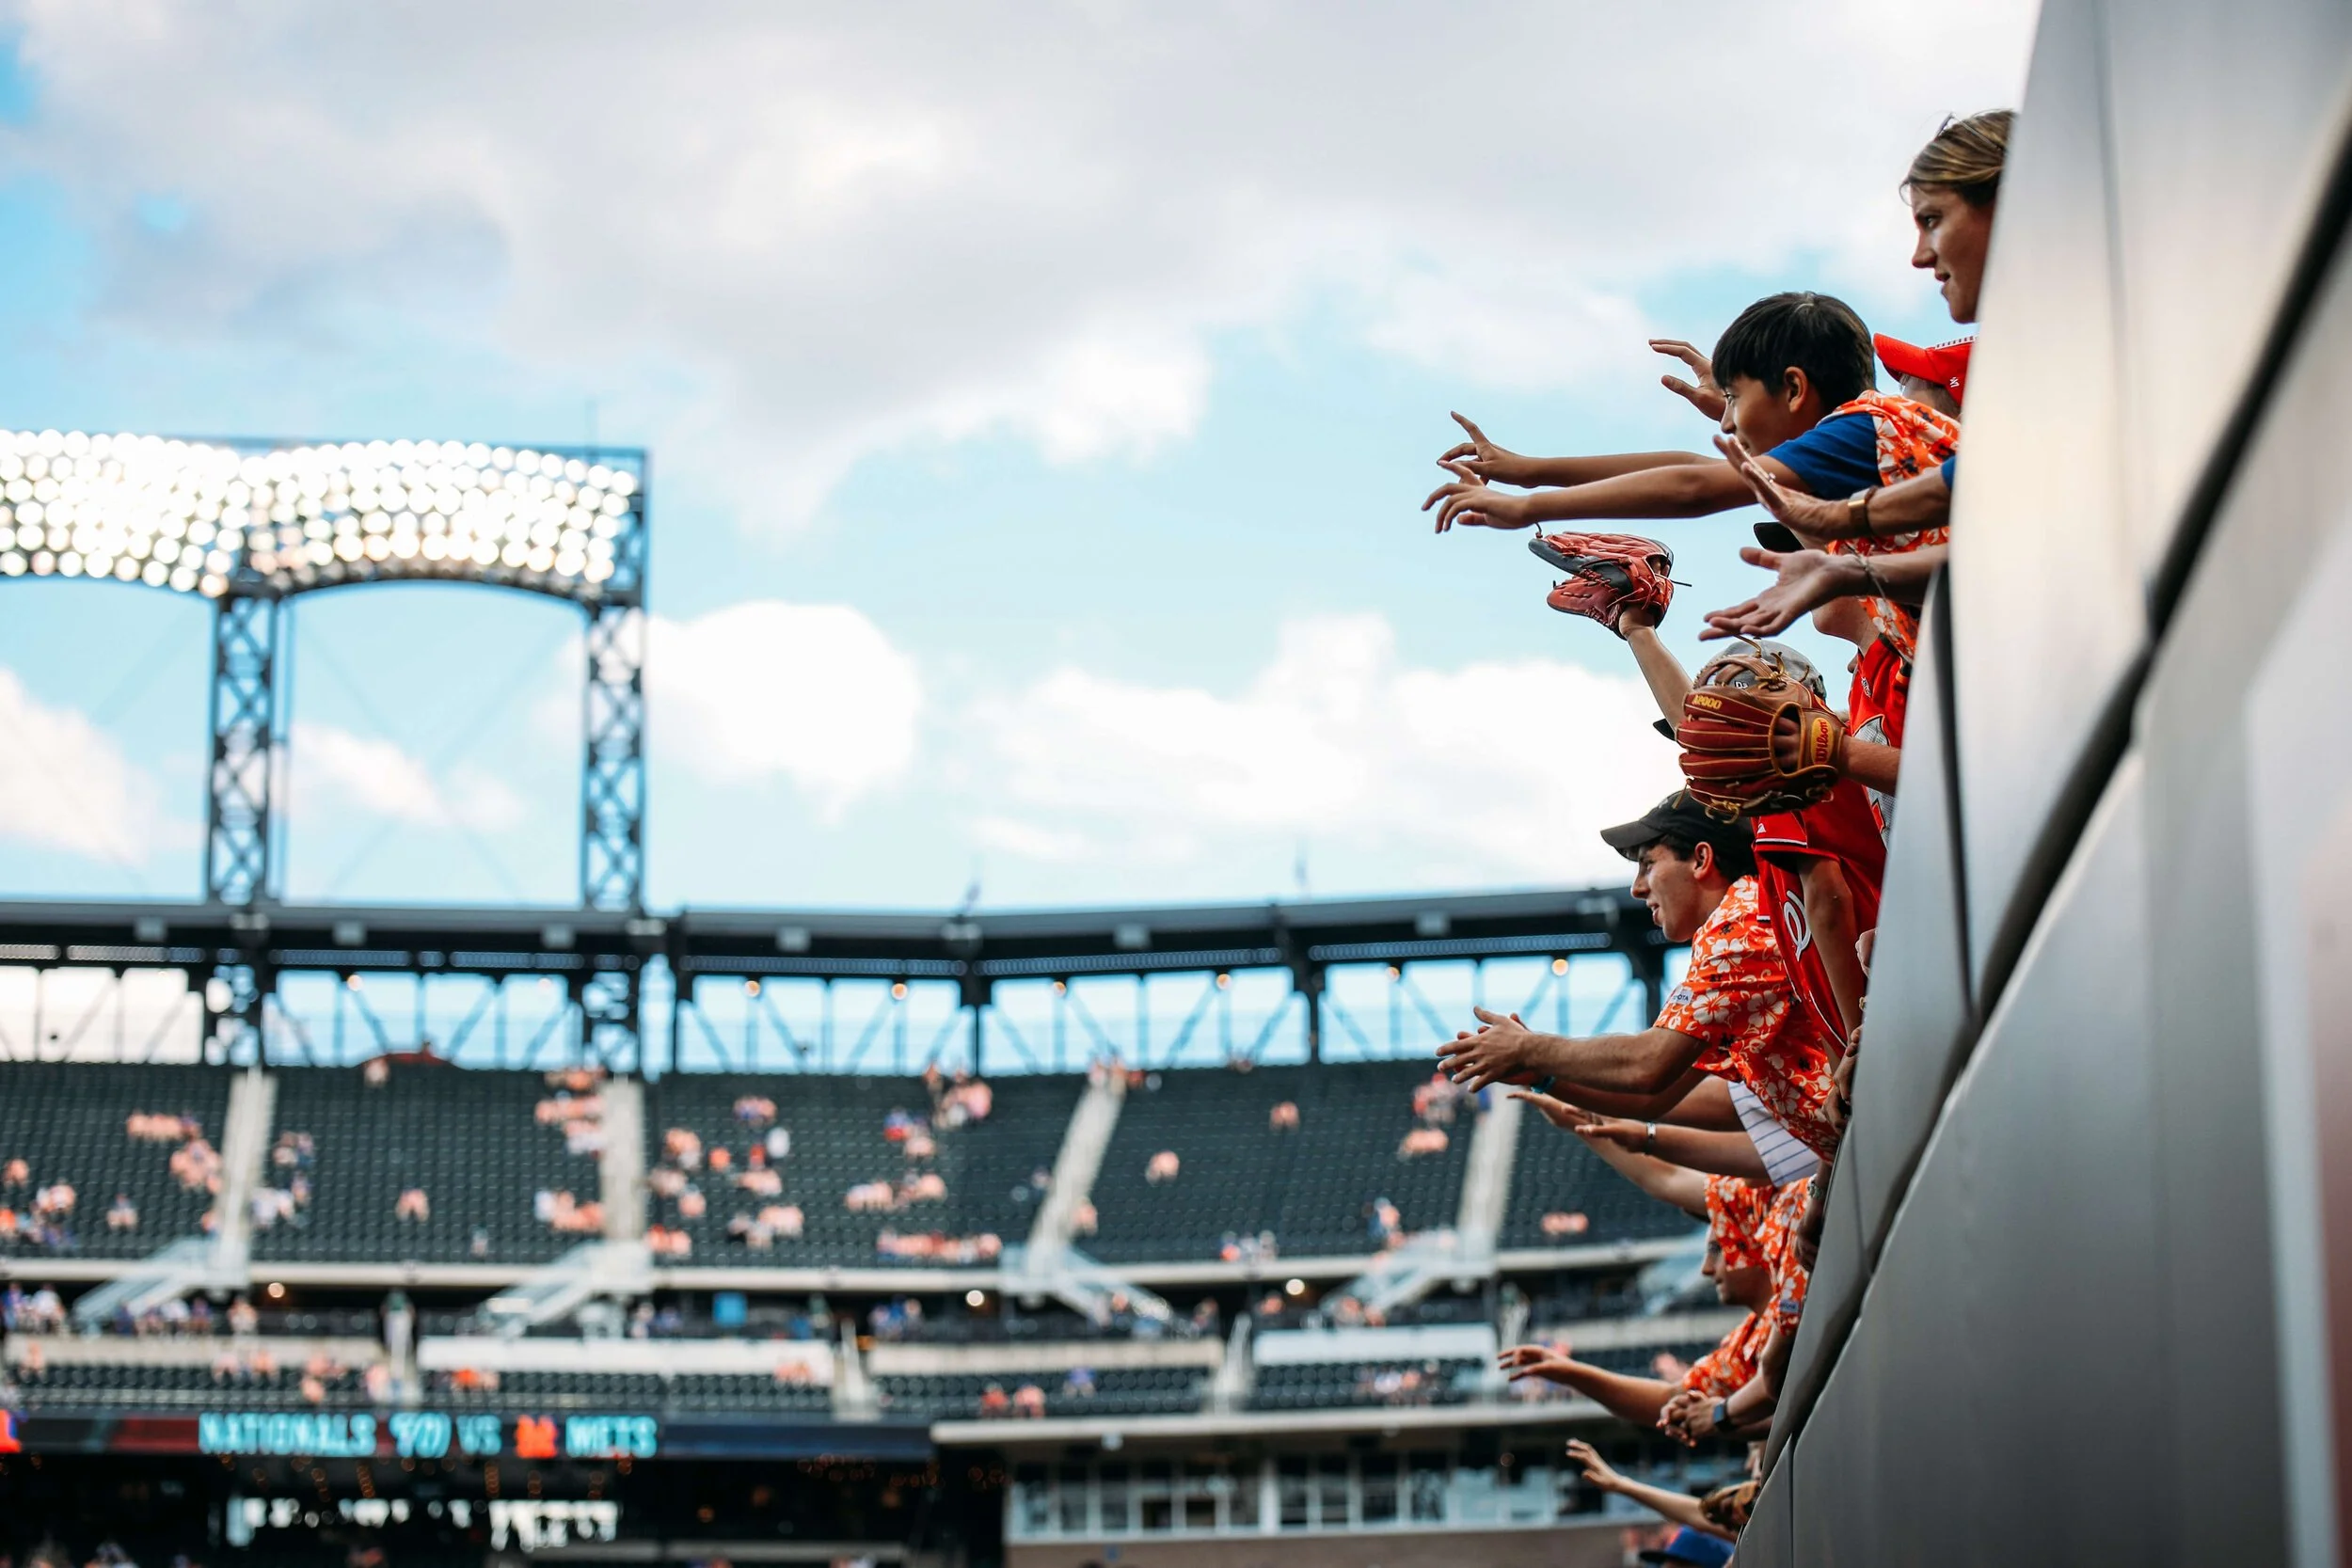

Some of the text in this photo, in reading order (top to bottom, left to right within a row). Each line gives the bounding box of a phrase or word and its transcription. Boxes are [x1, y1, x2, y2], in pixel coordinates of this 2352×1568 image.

[1815, 721, 1829, 764] Wilson
[199, 1413, 375, 1457] NATIONALS
[456, 1415, 501, 1455] VS
[565, 1416, 657, 1458] METS
